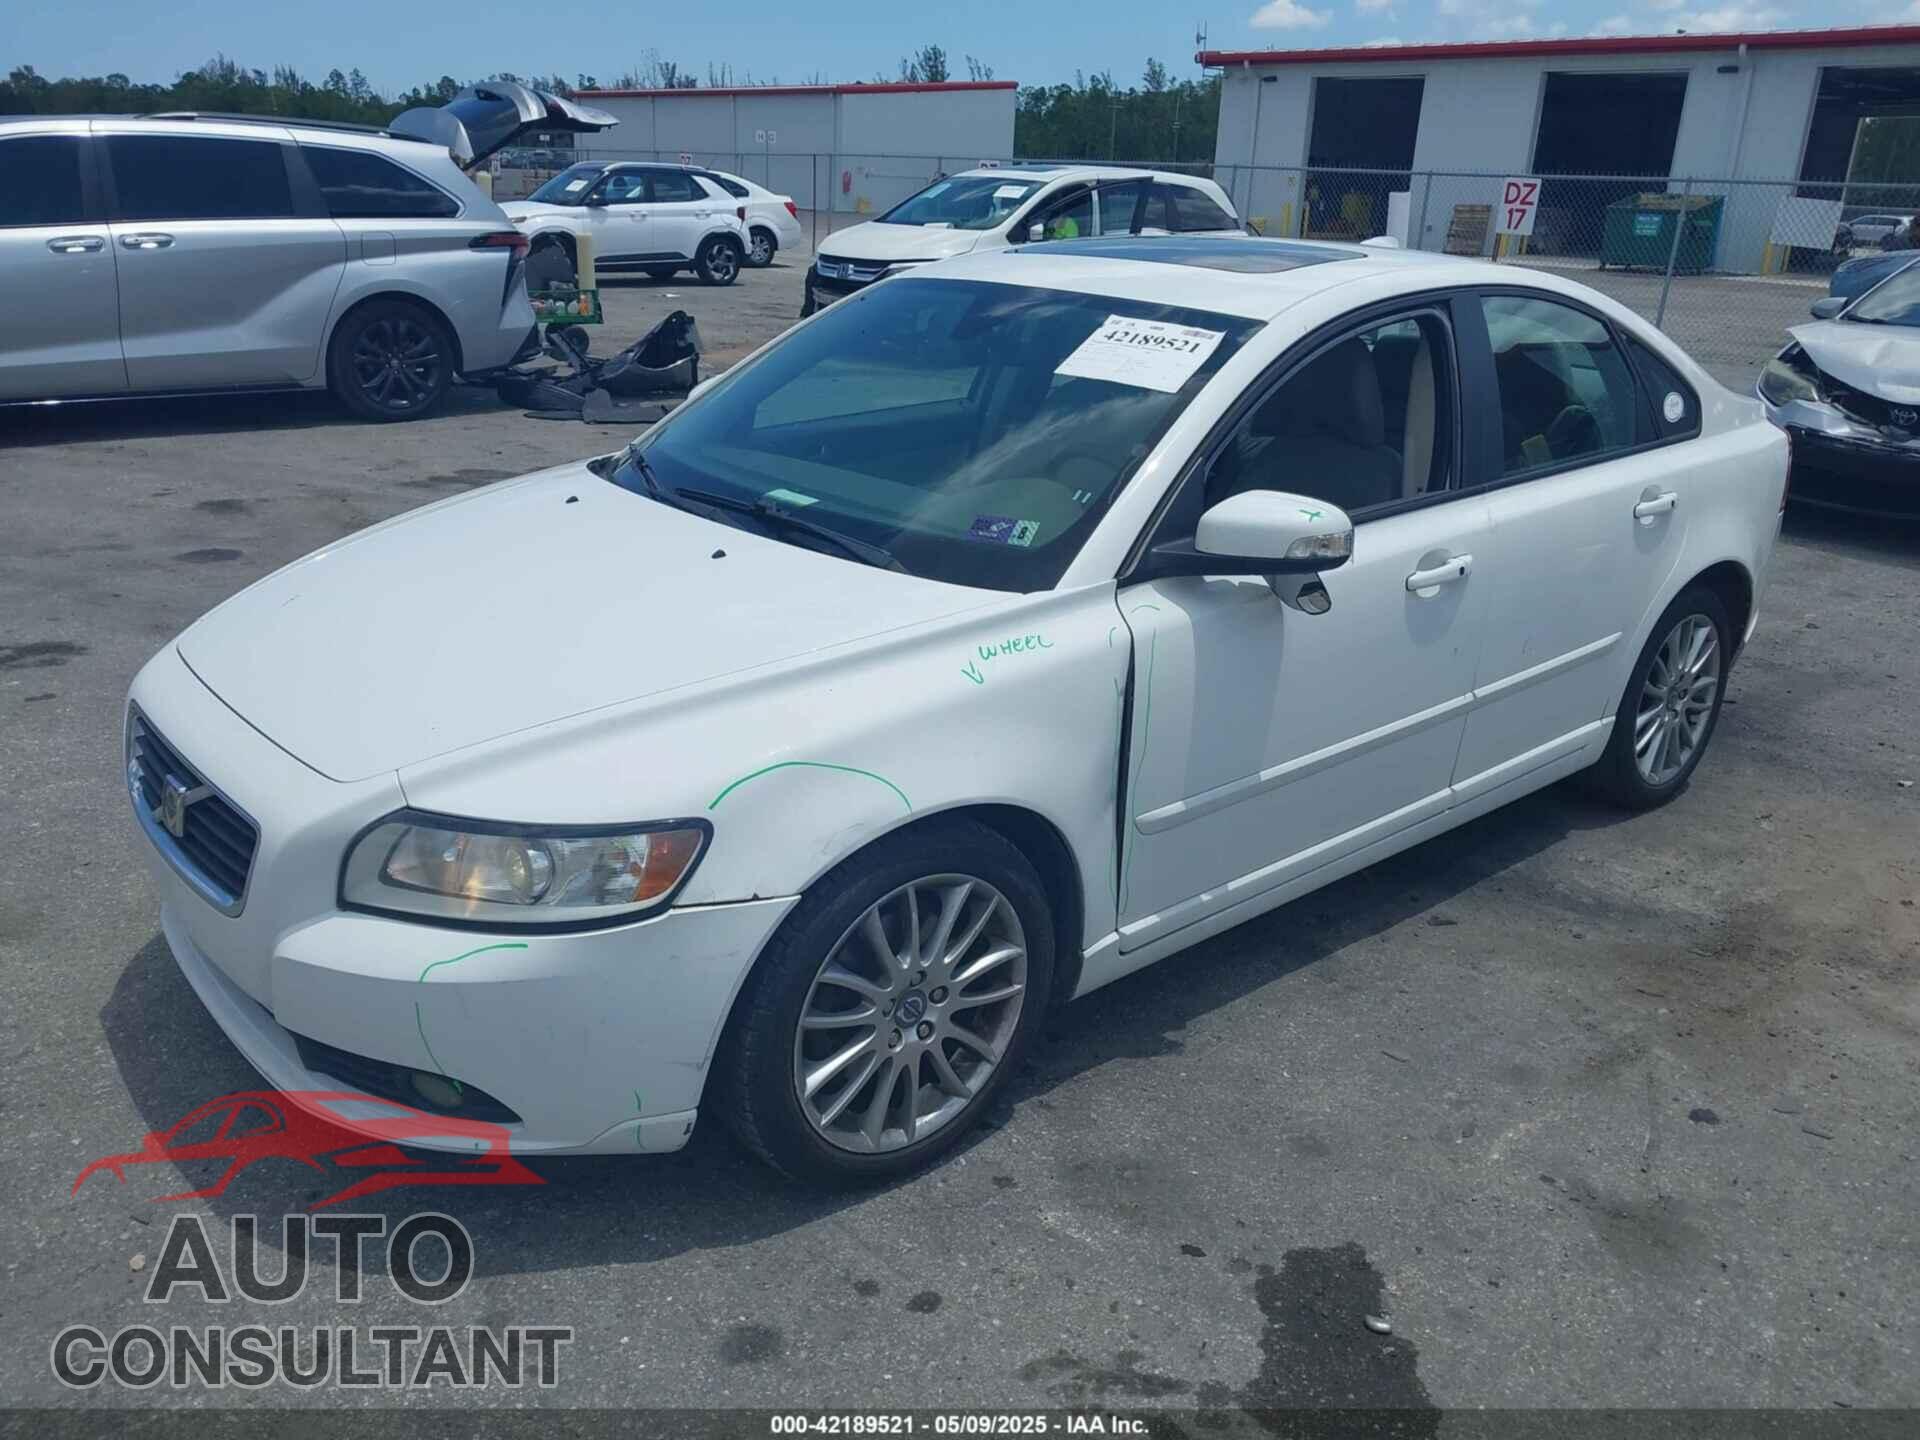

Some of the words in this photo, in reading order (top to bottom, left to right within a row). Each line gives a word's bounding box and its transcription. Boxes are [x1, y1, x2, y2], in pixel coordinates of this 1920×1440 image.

[1504, 182, 1537, 205] DZ
[1507, 208, 1527, 230] 17
[1104, 330, 1201, 353] 42189521
[978, 634, 1054, 660] WHEEL
